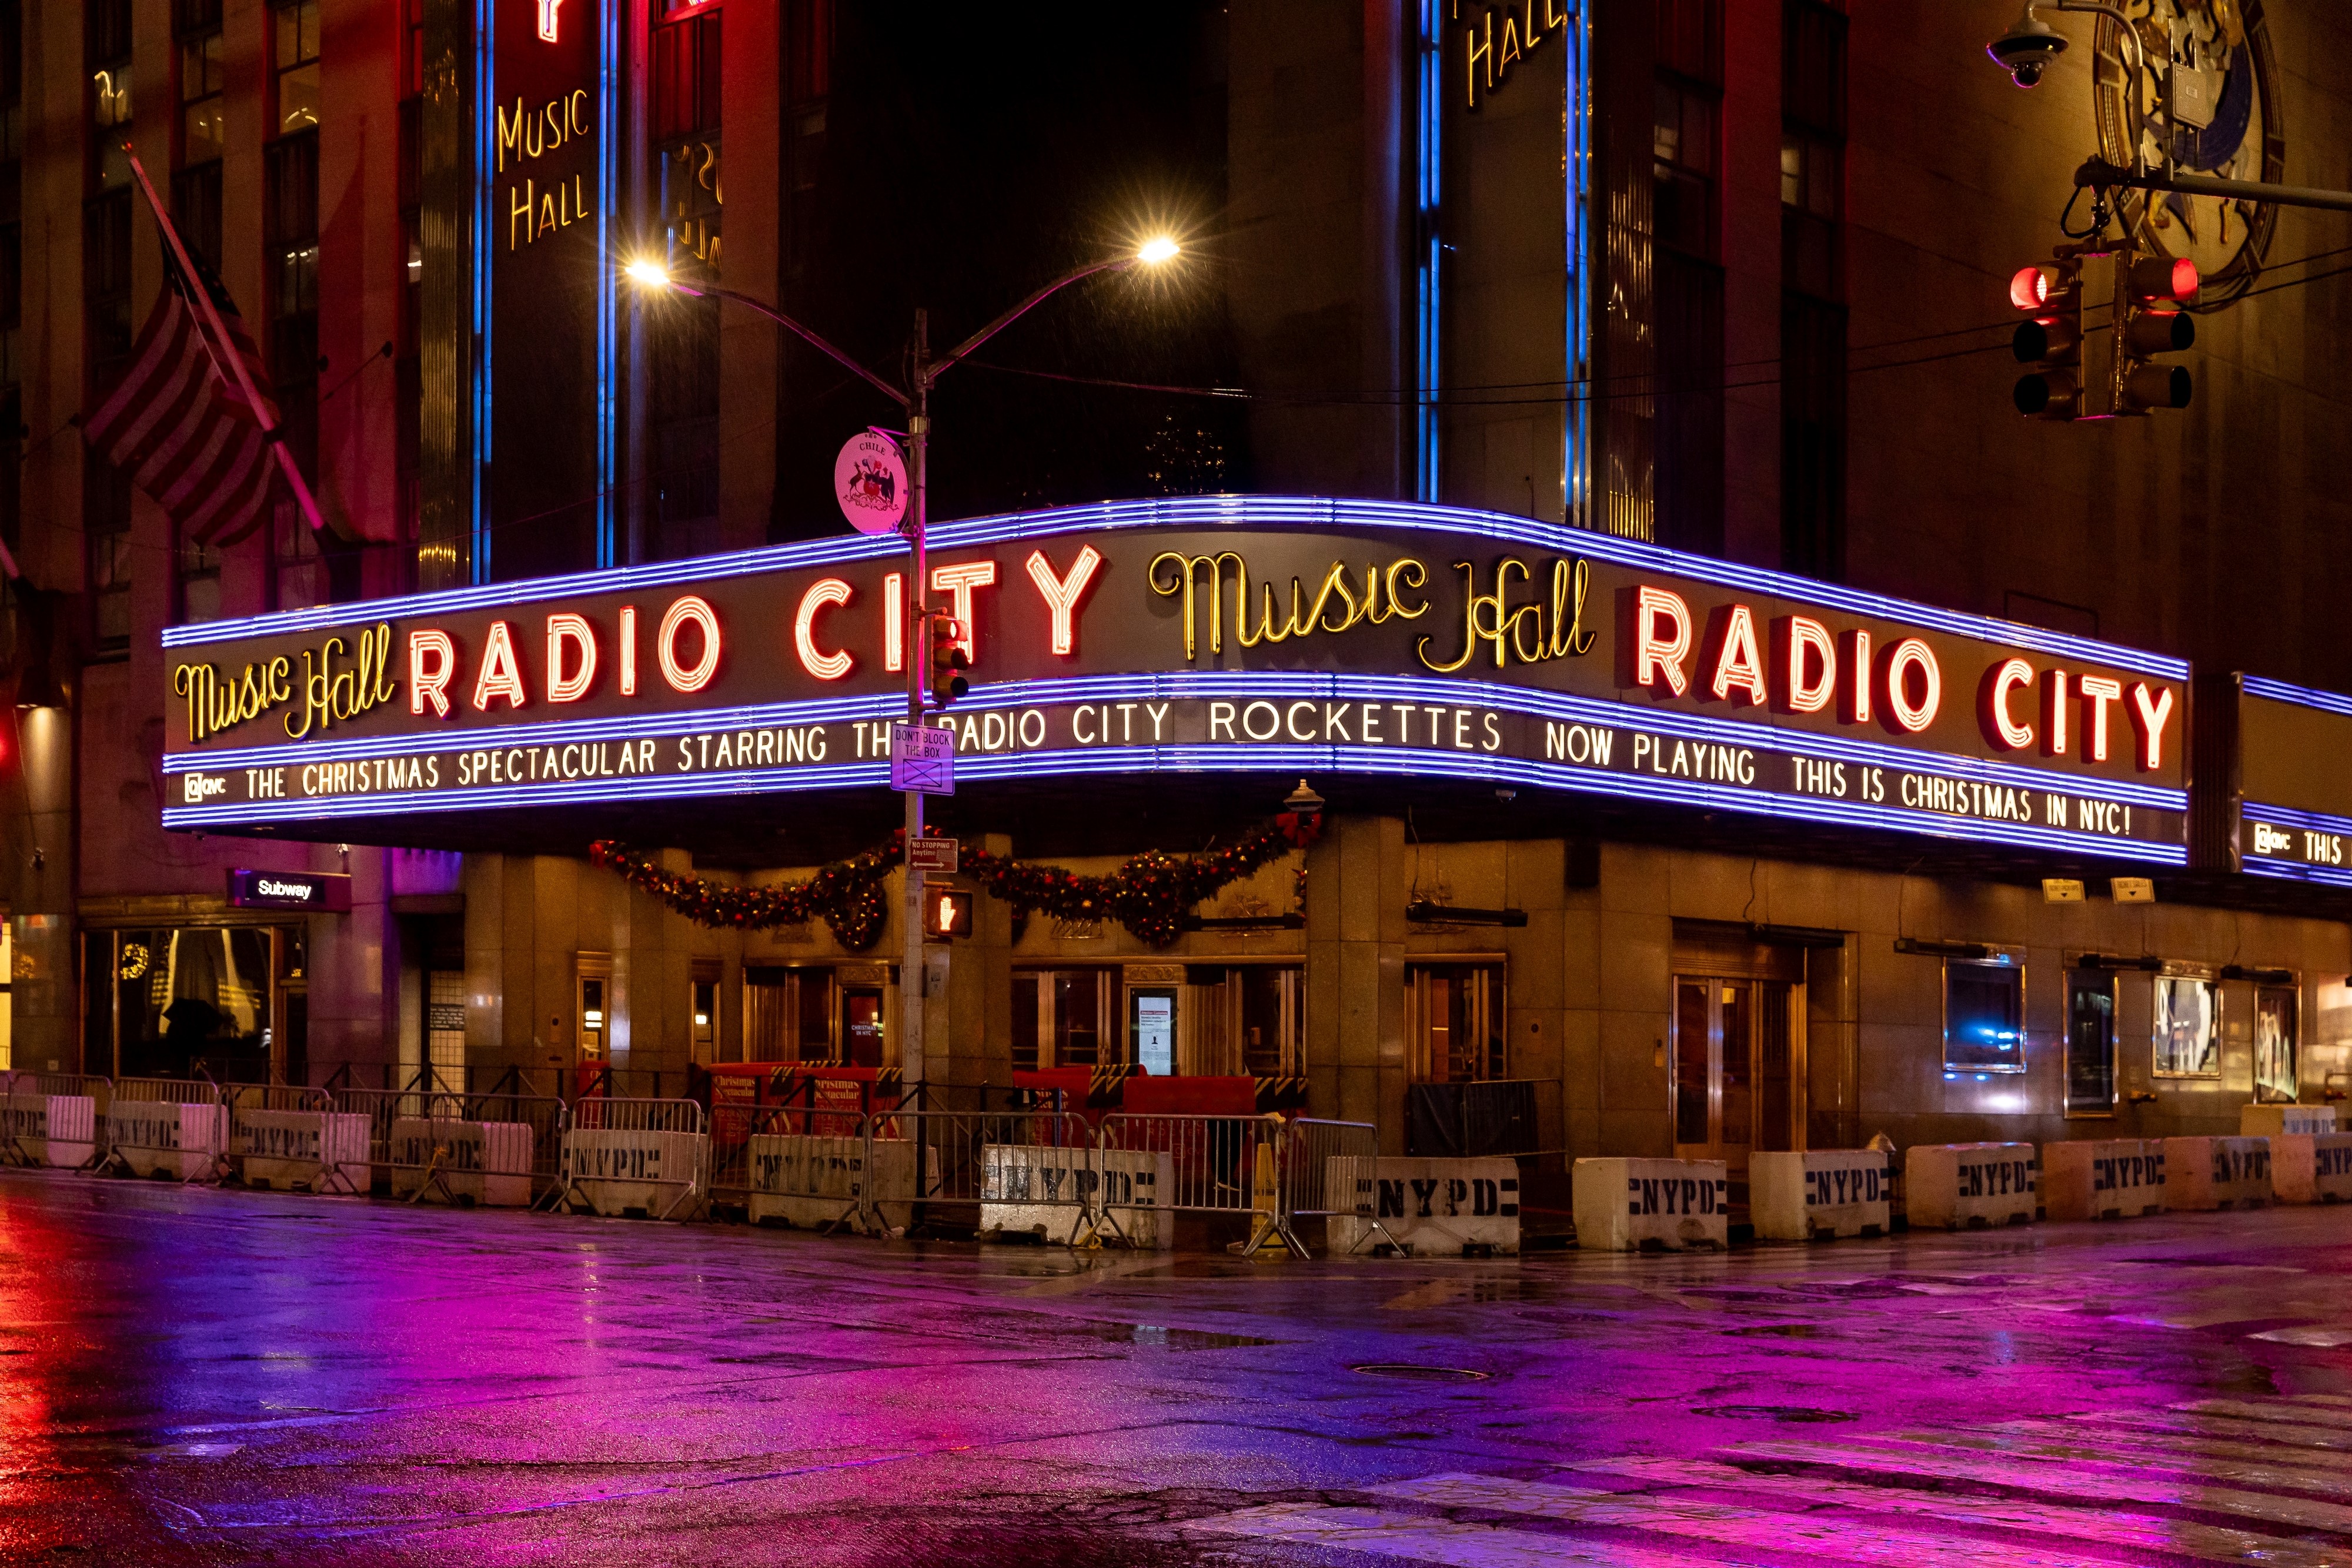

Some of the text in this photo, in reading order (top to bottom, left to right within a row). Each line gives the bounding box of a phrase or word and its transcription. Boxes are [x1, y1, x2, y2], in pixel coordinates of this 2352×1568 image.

[1469, 0, 1562, 106] HALL
[498, 89, 588, 172] MUSIC
[511, 175, 589, 250] HALL
[859, 442, 886, 456] CHILE
[1147, 550, 1596, 673] Music Hall
[410, 544, 1102, 718] RADIO CITY
[175, 620, 396, 743] Music Hall
[1638, 585, 2173, 770] RADIO CITY
[246, 767, 286, 799] THE
[302, 755, 439, 796] CHRISTMAS
[458, 738, 656, 785] SPECTACULAR
[677, 726, 826, 771] STARRING
[853, 719, 908, 758] TH
[1073, 703, 1169, 744] CITY
[1210, 701, 1501, 751] ROCKETTES
[896, 729, 950, 746] DON'T BLOCK
[906, 744, 940, 758] THE BOX
[1546, 721, 2131, 836] NOW PLAYING THIS IS CHRISTMAS IN NYC!
[912, 849, 936, 857] Anytime
[2304, 831, 2342, 865] THIS
[258, 879, 312, 900] Subway
[576, 1148, 644, 1178] NYPD
[1969, 1161, 2027, 1197] NYPD
[2103, 1154, 2157, 1190] NYPD
[2322, 1147, 2352, 1175] NYP
[1378, 1178, 1498, 1218] NYPD
[1642, 1178, 1716, 1215] NYPD
[1817, 1168, 1879, 1206] NYPD
